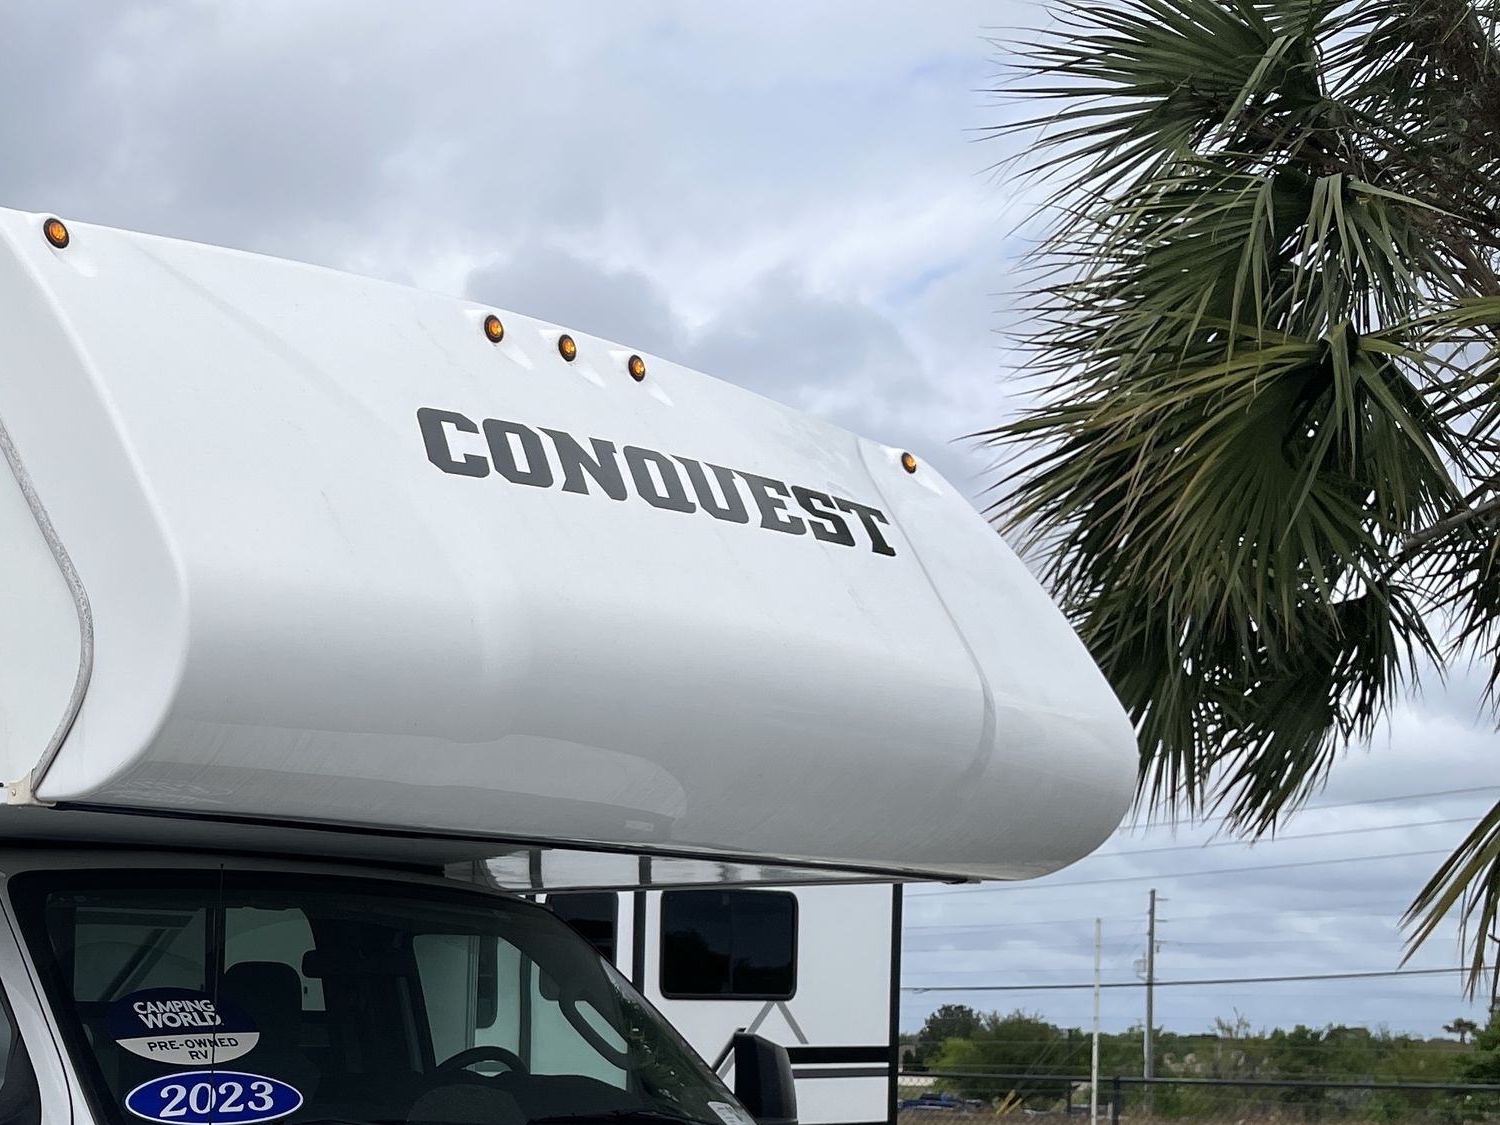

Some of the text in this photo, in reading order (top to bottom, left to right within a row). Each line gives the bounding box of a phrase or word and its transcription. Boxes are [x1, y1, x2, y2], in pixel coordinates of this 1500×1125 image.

[416, 406, 897, 558] CONQUEST
[132, 999, 216, 1015] CAMPING
[138, 1010, 222, 1029] WORLD
[146, 1037, 239, 1052] PRE-OWNED
[188, 1049, 209, 1061] RV
[159, 1081, 274, 1118] 2023
